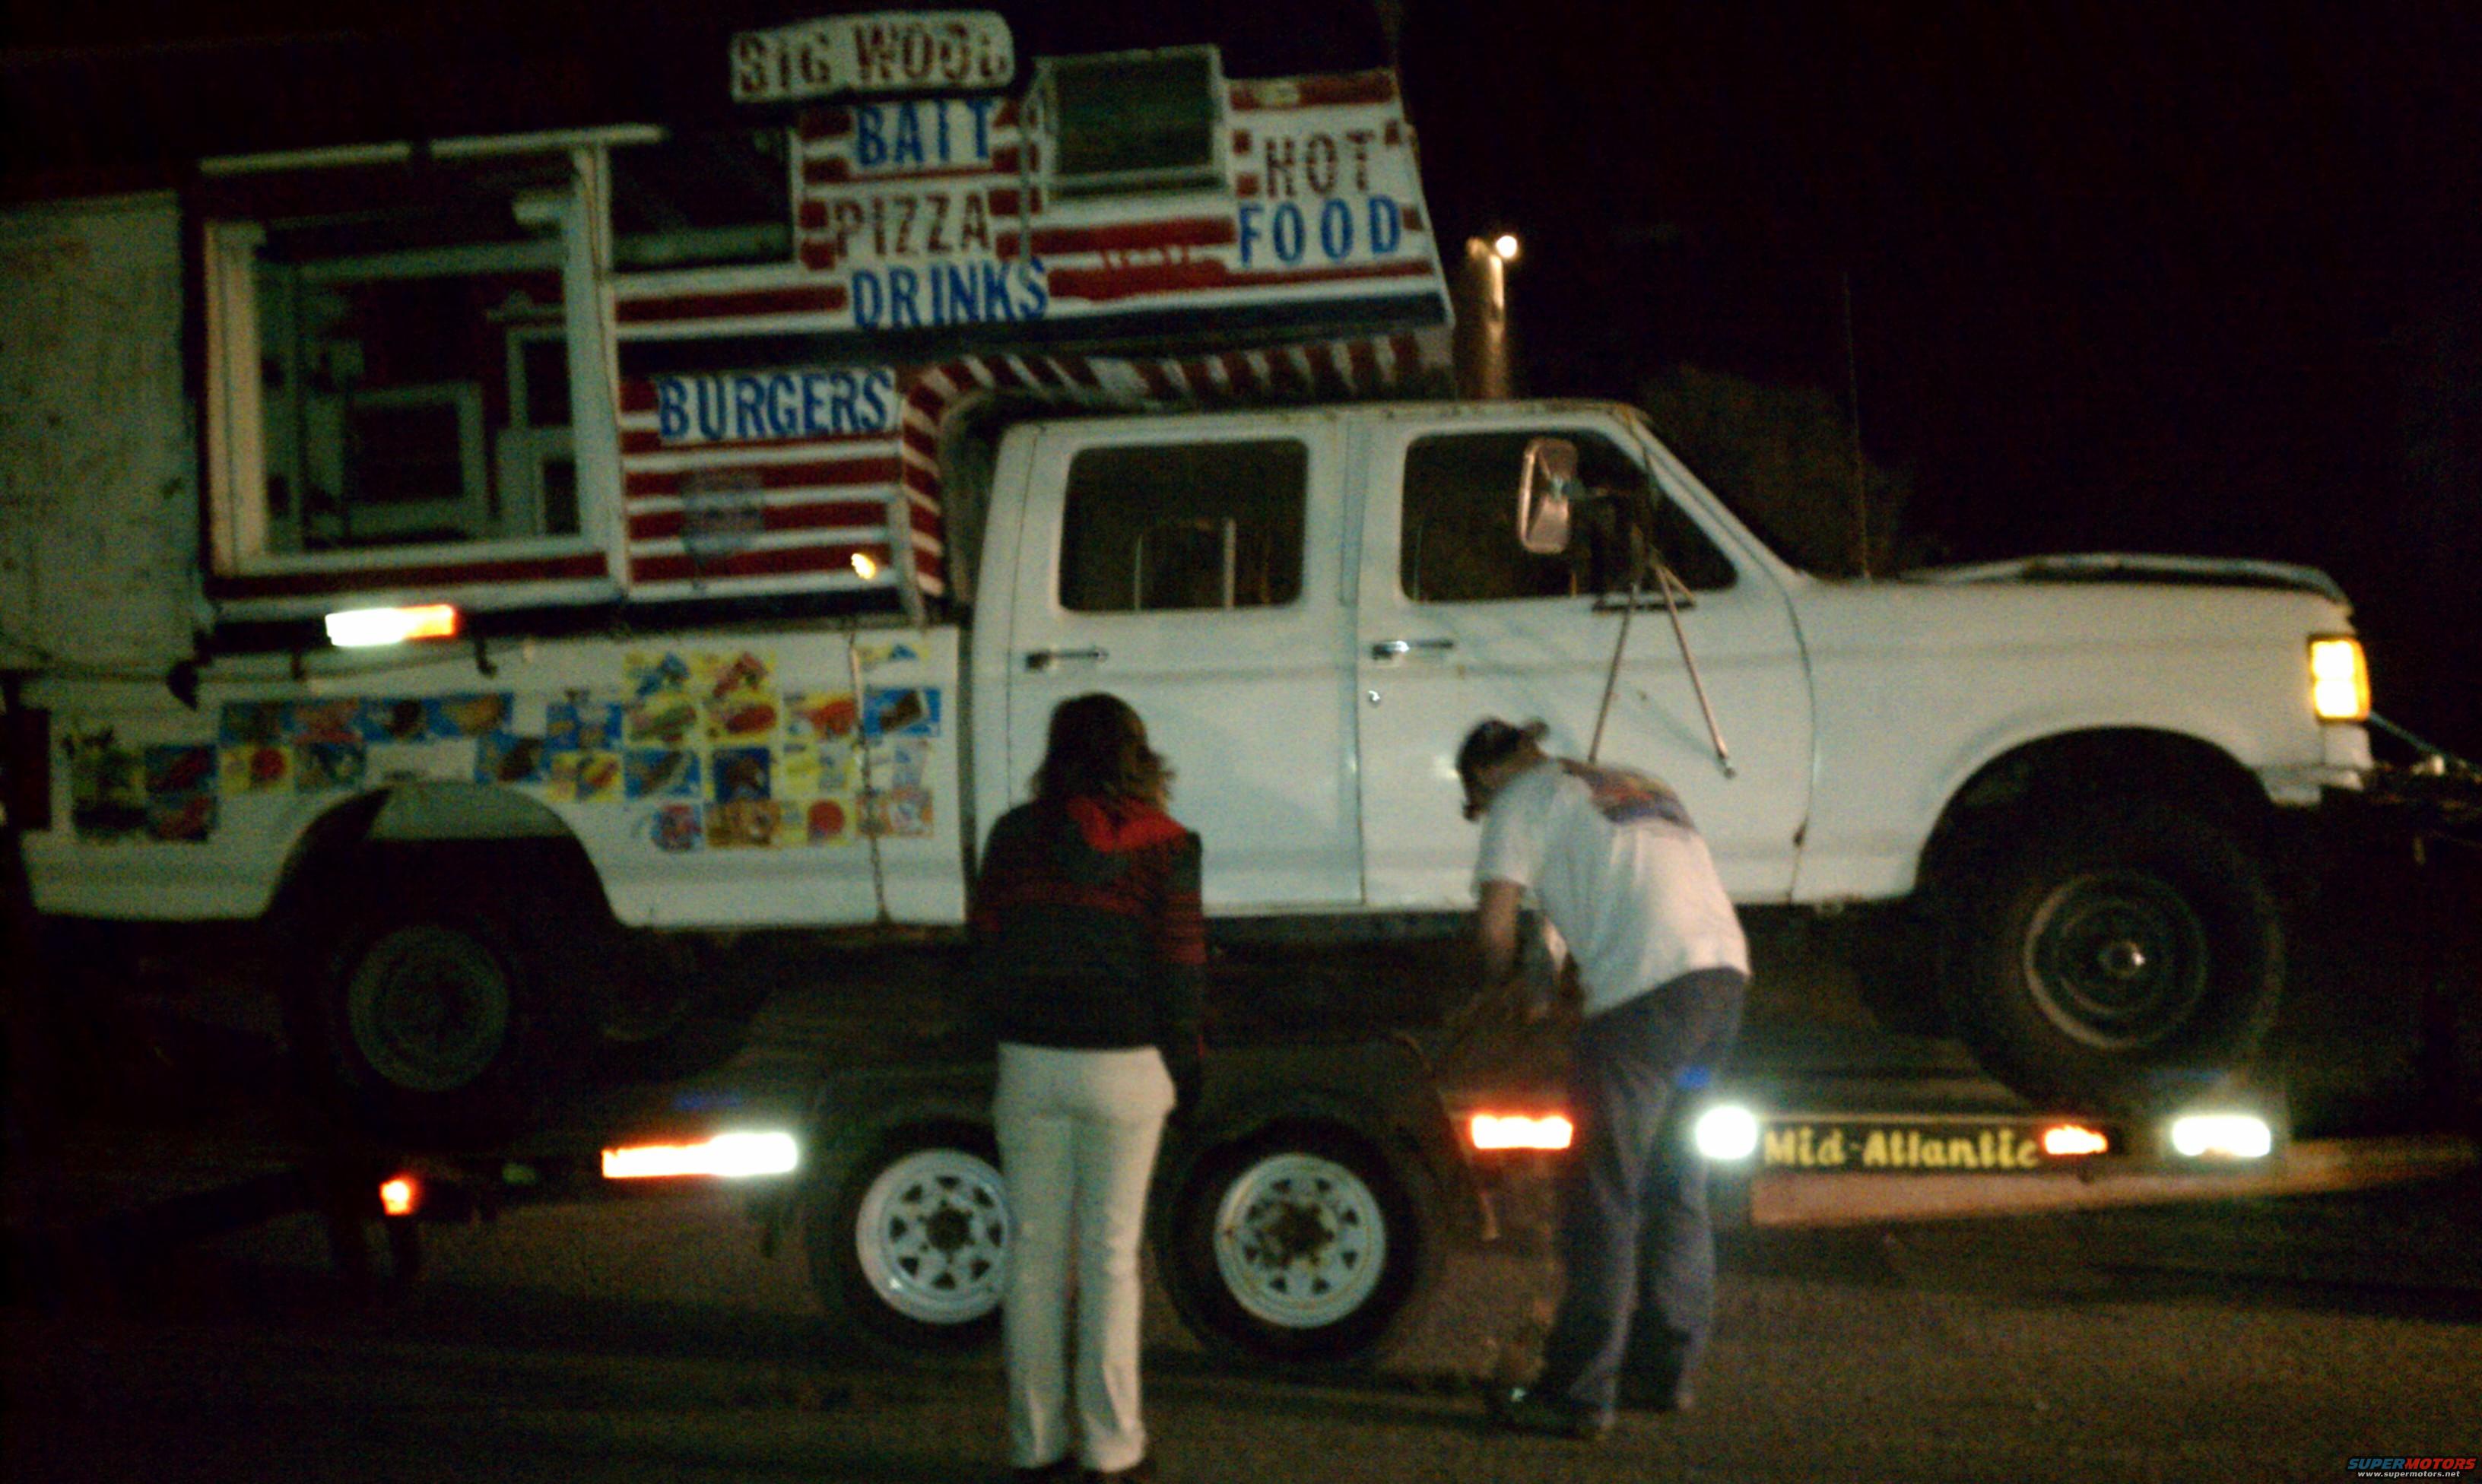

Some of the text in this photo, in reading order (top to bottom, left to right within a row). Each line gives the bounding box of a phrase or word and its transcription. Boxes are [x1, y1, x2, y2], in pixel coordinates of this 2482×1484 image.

[857, 100, 992, 166] BAIT
[1265, 132, 1374, 198] HOT
[836, 195, 990, 257] PIZZA
[1239, 195, 1399, 267] FOOD
[852, 257, 1049, 328] DRINKS
[659, 370, 893, 439] BURGERS
